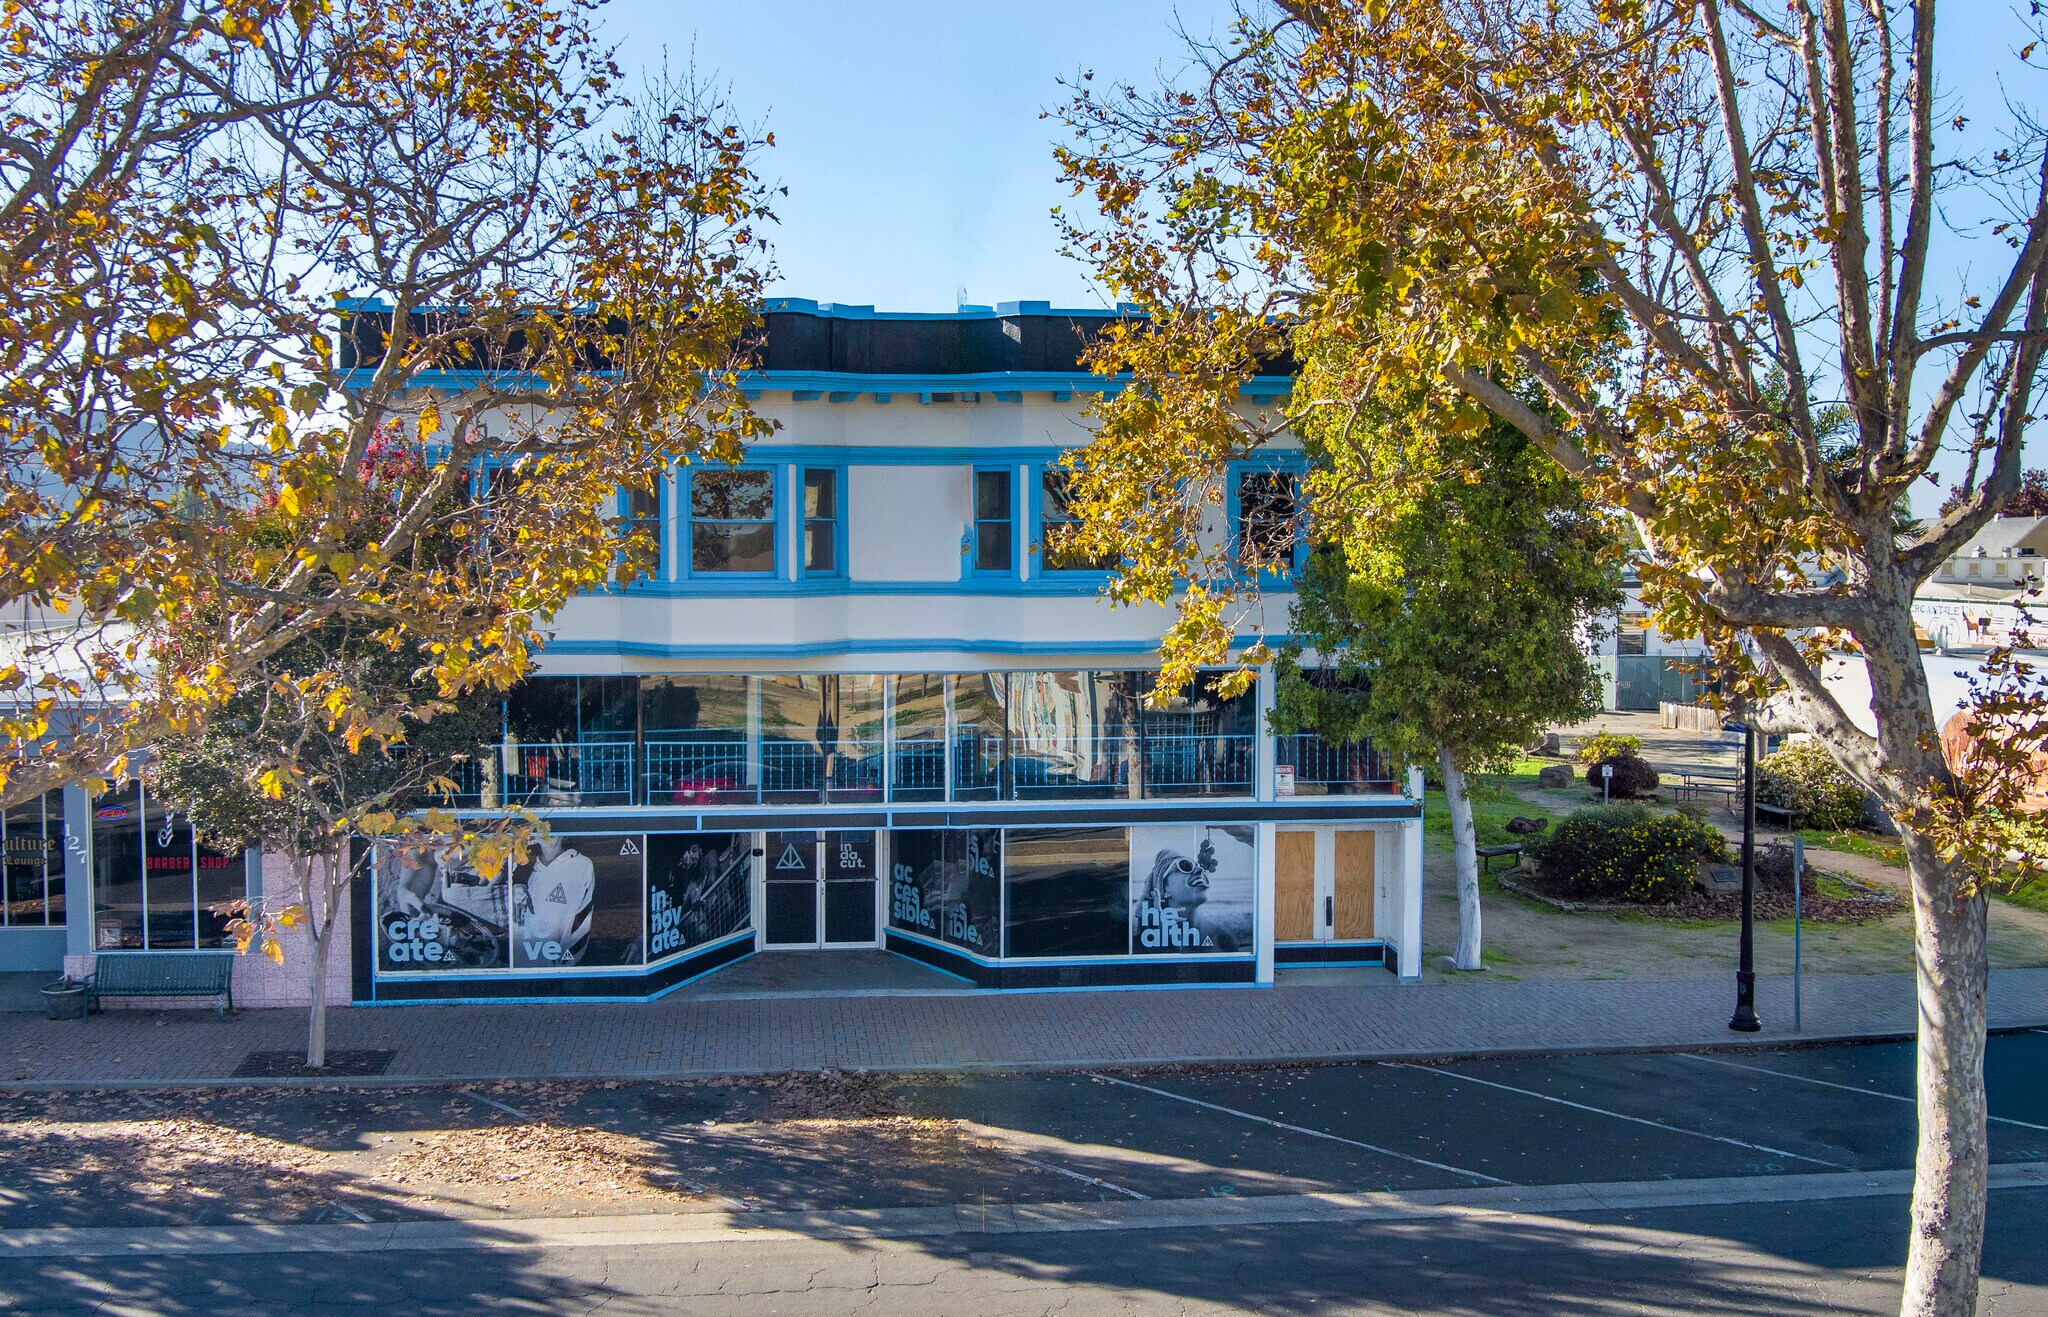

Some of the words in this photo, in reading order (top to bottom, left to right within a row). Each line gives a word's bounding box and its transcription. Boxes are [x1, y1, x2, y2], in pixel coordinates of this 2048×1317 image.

[1911, 604, 1960, 615] ERCANTILE
[96, 808, 127, 818] OPEN
[4, 854, 46, 867] Lounge
[147, 857, 190, 870] BARBER
[200, 857, 229, 869] SHOP
[840, 850, 858, 860] da
[840, 858, 866, 868] cut.
[894, 863, 913, 883] ac
[651, 885, 667, 911] in
[894, 882, 919, 903] ces
[651, 906, 683, 933] nov
[894, 896, 930, 927] sible
[1142, 901, 1179, 926] he
[388, 919, 440, 940] cre
[523, 912, 551, 939] lo
[1141, 920, 1200, 948] alth
[388, 939, 444, 962] ate
[523, 940, 562, 961] ve
[651, 927, 680, 954] ate
